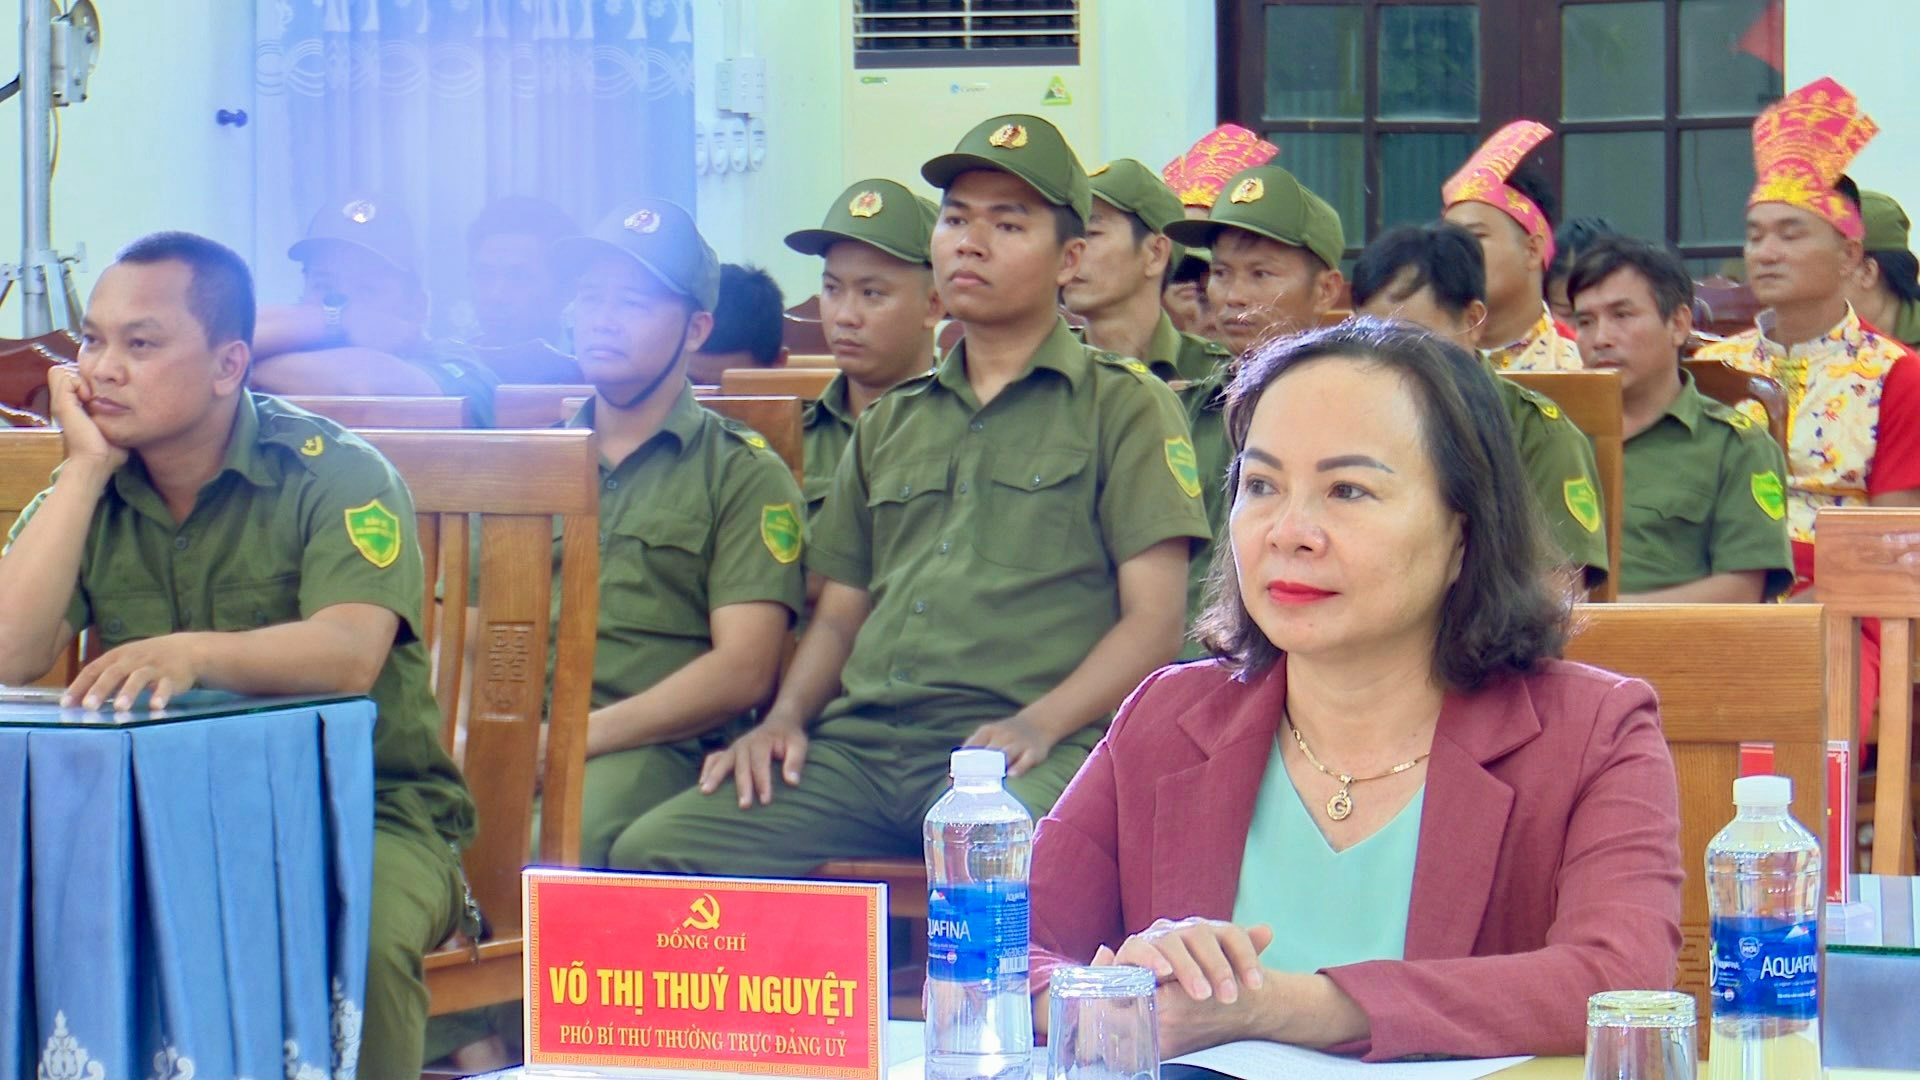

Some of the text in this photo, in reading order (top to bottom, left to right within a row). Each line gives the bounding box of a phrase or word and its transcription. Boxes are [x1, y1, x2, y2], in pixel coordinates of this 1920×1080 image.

[656, 927, 747, 952] ĐỒNG CHÍ
[549, 960, 858, 1025] VÕ THỊ THUÝ NGUYỆT
[560, 1020, 847, 1057] PHÓ BÍ THƯ THƯỜNG TRỰC ĐẢNG UỶ
